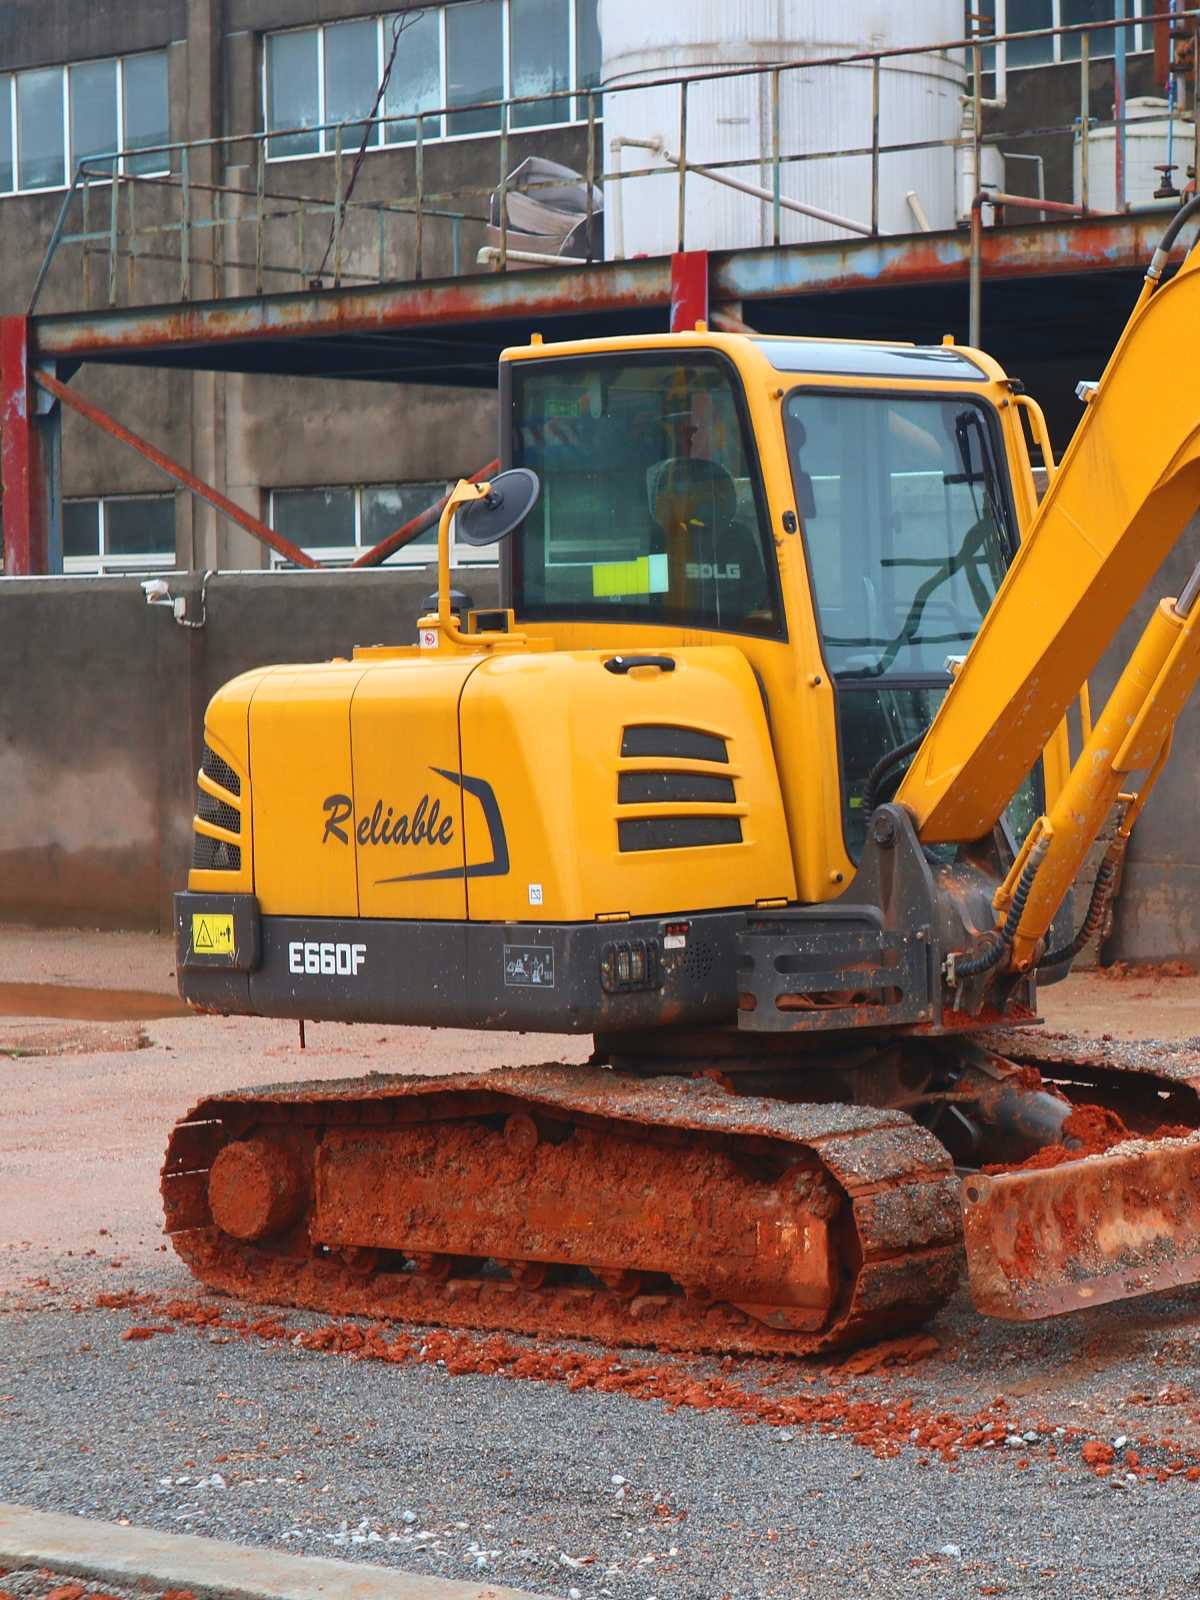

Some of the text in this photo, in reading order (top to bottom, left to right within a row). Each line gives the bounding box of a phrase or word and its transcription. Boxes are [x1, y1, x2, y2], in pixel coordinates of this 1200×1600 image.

[685, 563, 740, 579] SDLG
[322, 794, 455, 846] Reliable
[288, 942, 367, 976] E660F
